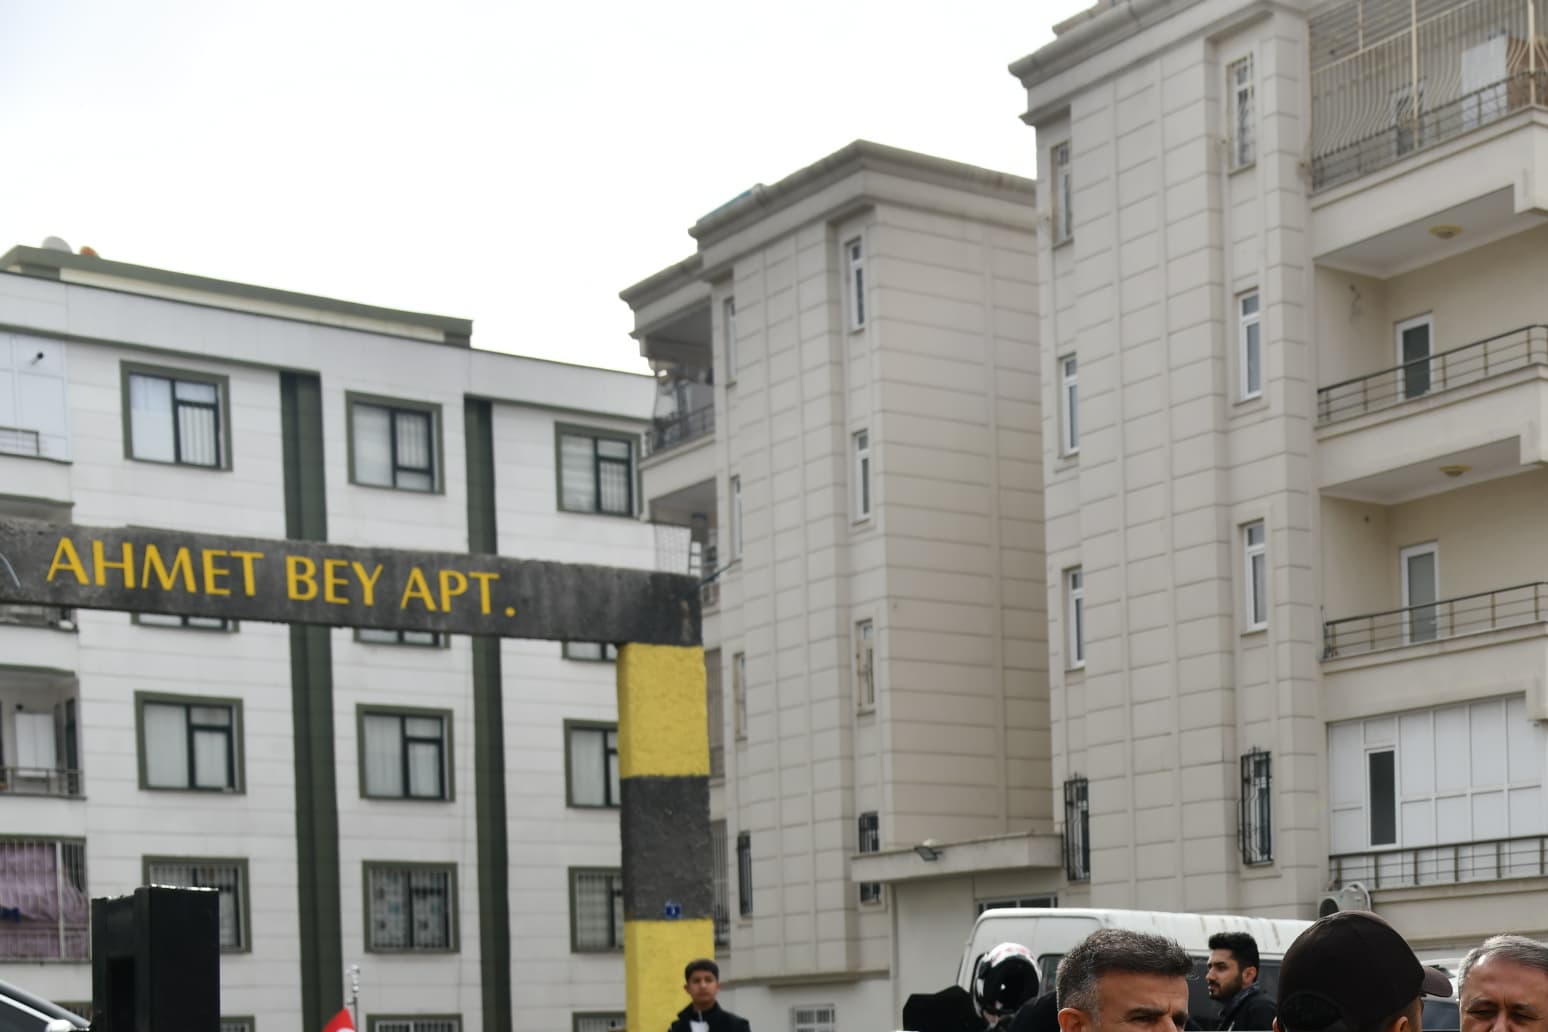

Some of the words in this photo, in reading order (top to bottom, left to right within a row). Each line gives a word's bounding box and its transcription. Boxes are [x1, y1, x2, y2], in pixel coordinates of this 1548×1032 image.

[46, 536, 264, 597] AHMET
[285, 555, 383, 606] BEY
[400, 567, 516, 617] APT.
